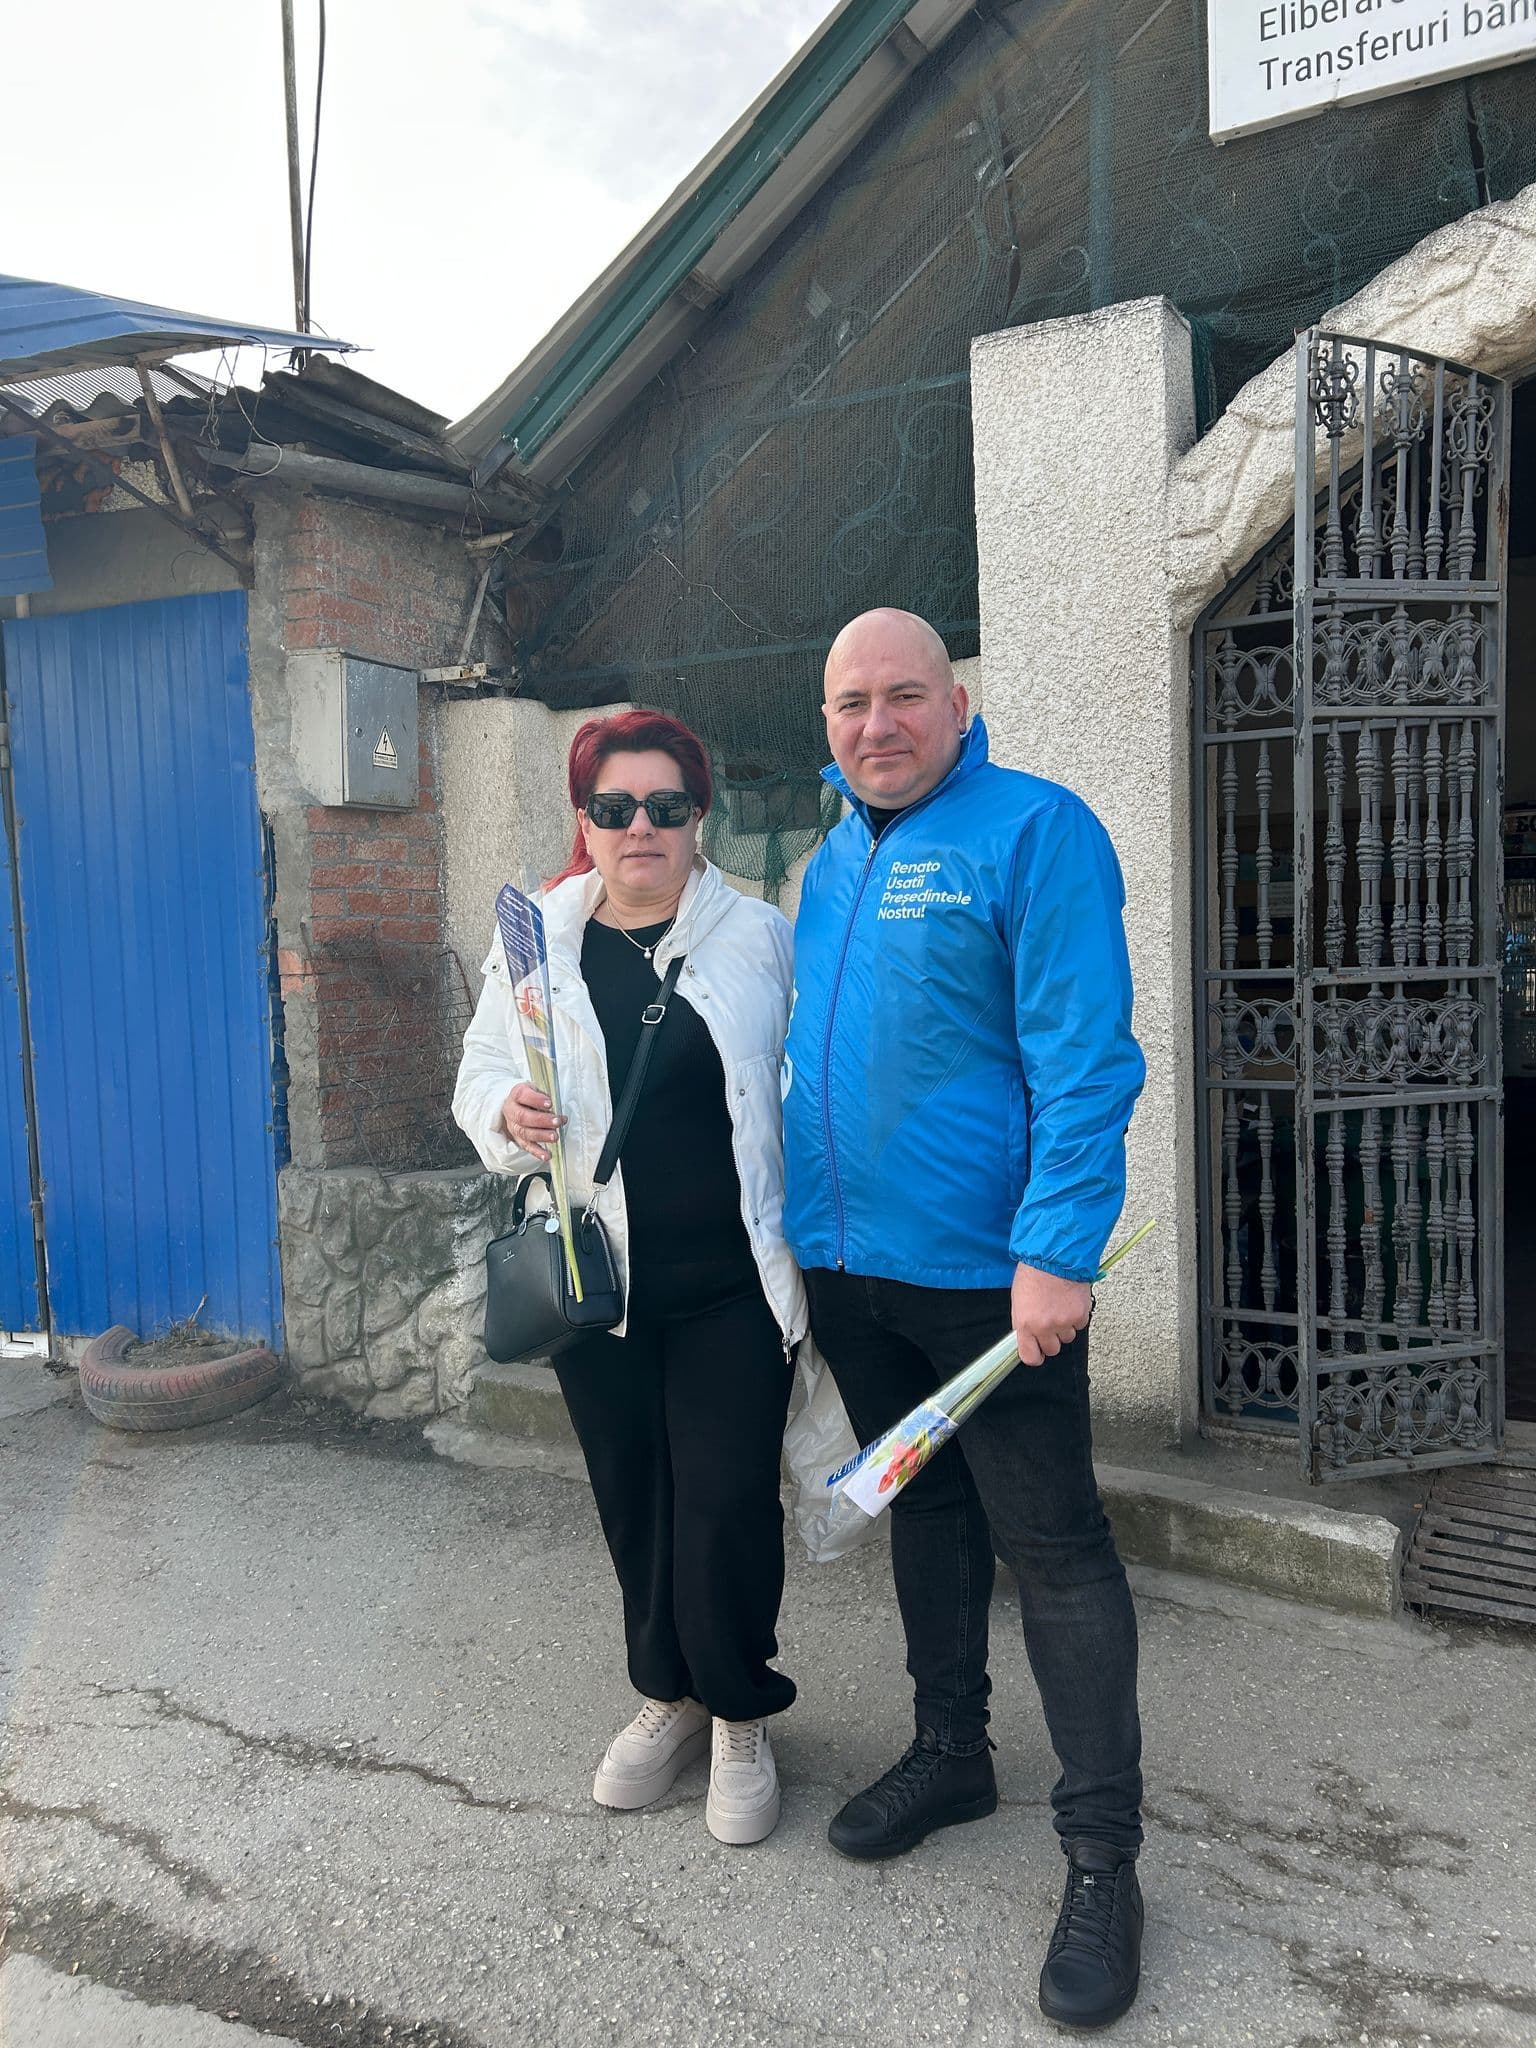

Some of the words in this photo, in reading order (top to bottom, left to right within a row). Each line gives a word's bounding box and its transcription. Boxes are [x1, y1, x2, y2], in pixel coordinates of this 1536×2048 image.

[1258, 9, 1449, 90] Transferuri
[1463, 0, 1536, 37] băn
[890, 861, 941, 874] Renato
[880, 888, 972, 905] Președintele
[877, 904, 927, 921] Nostru!
